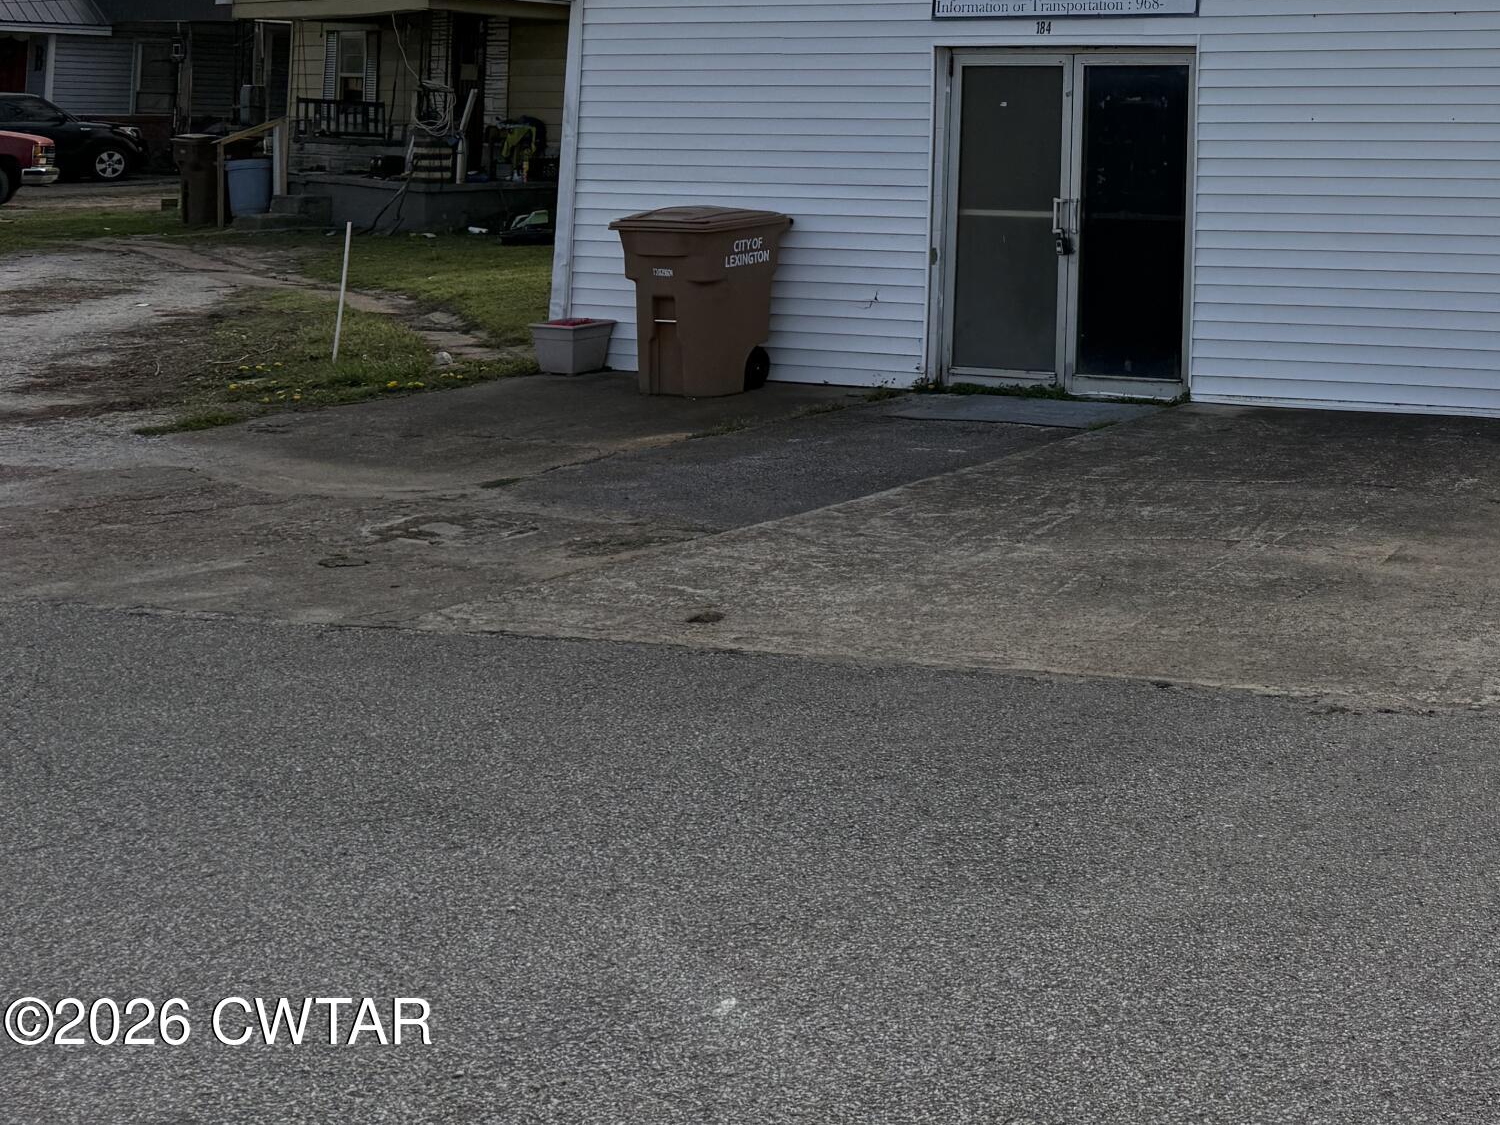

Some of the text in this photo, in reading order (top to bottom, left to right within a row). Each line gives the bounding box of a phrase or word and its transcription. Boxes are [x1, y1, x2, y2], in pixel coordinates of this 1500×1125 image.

[936, 0, 1008, 13] Information
[1012, 3, 1026, 12] or
[1036, 21, 1052, 35] 184
[733, 236, 763, 252] CITY OF
[725, 249, 770, 268] LEXINGTON
